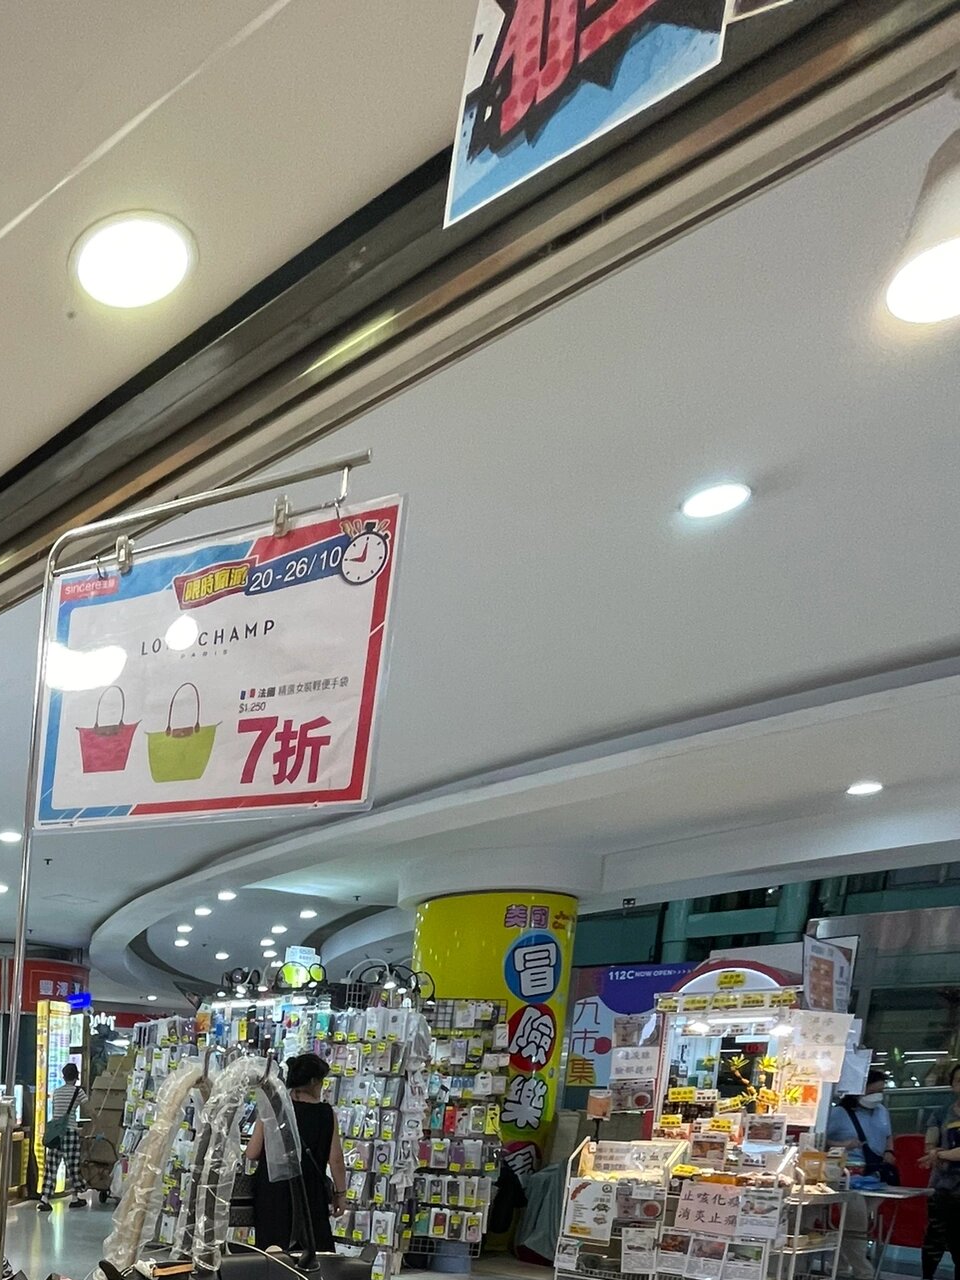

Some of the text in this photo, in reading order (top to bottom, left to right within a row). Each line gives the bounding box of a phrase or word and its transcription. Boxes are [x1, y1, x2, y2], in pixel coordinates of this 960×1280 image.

[249, 546, 341, 592] 20-26/10
[64, 581, 102, 595] sincere
[141, 619, 276, 655] LOCHAMP
[237, 715, 332, 785] 7折
[504, 904, 549, 929] 美國
[608, 970, 635, 980] 112C
